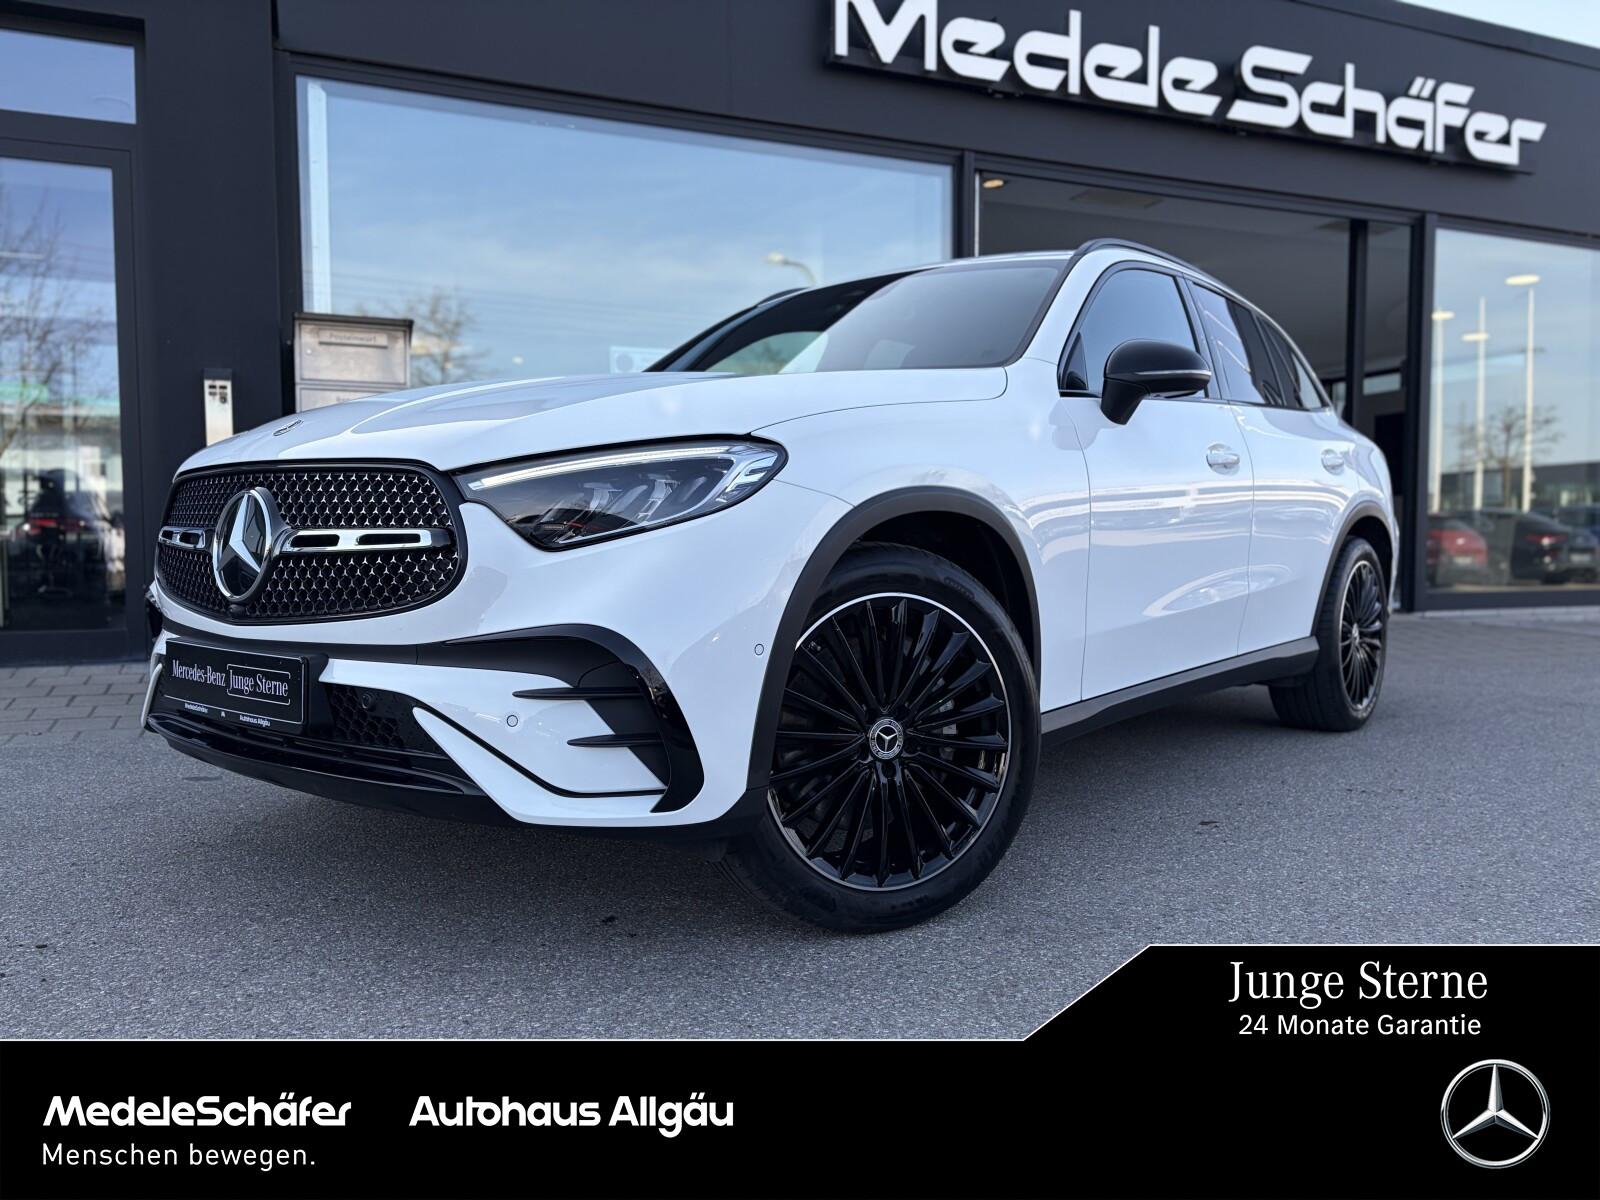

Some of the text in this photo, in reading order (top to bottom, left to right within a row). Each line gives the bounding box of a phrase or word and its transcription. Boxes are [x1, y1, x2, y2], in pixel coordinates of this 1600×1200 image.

[171, 659, 289, 697] Mercedes-Benz Junge Sterne
